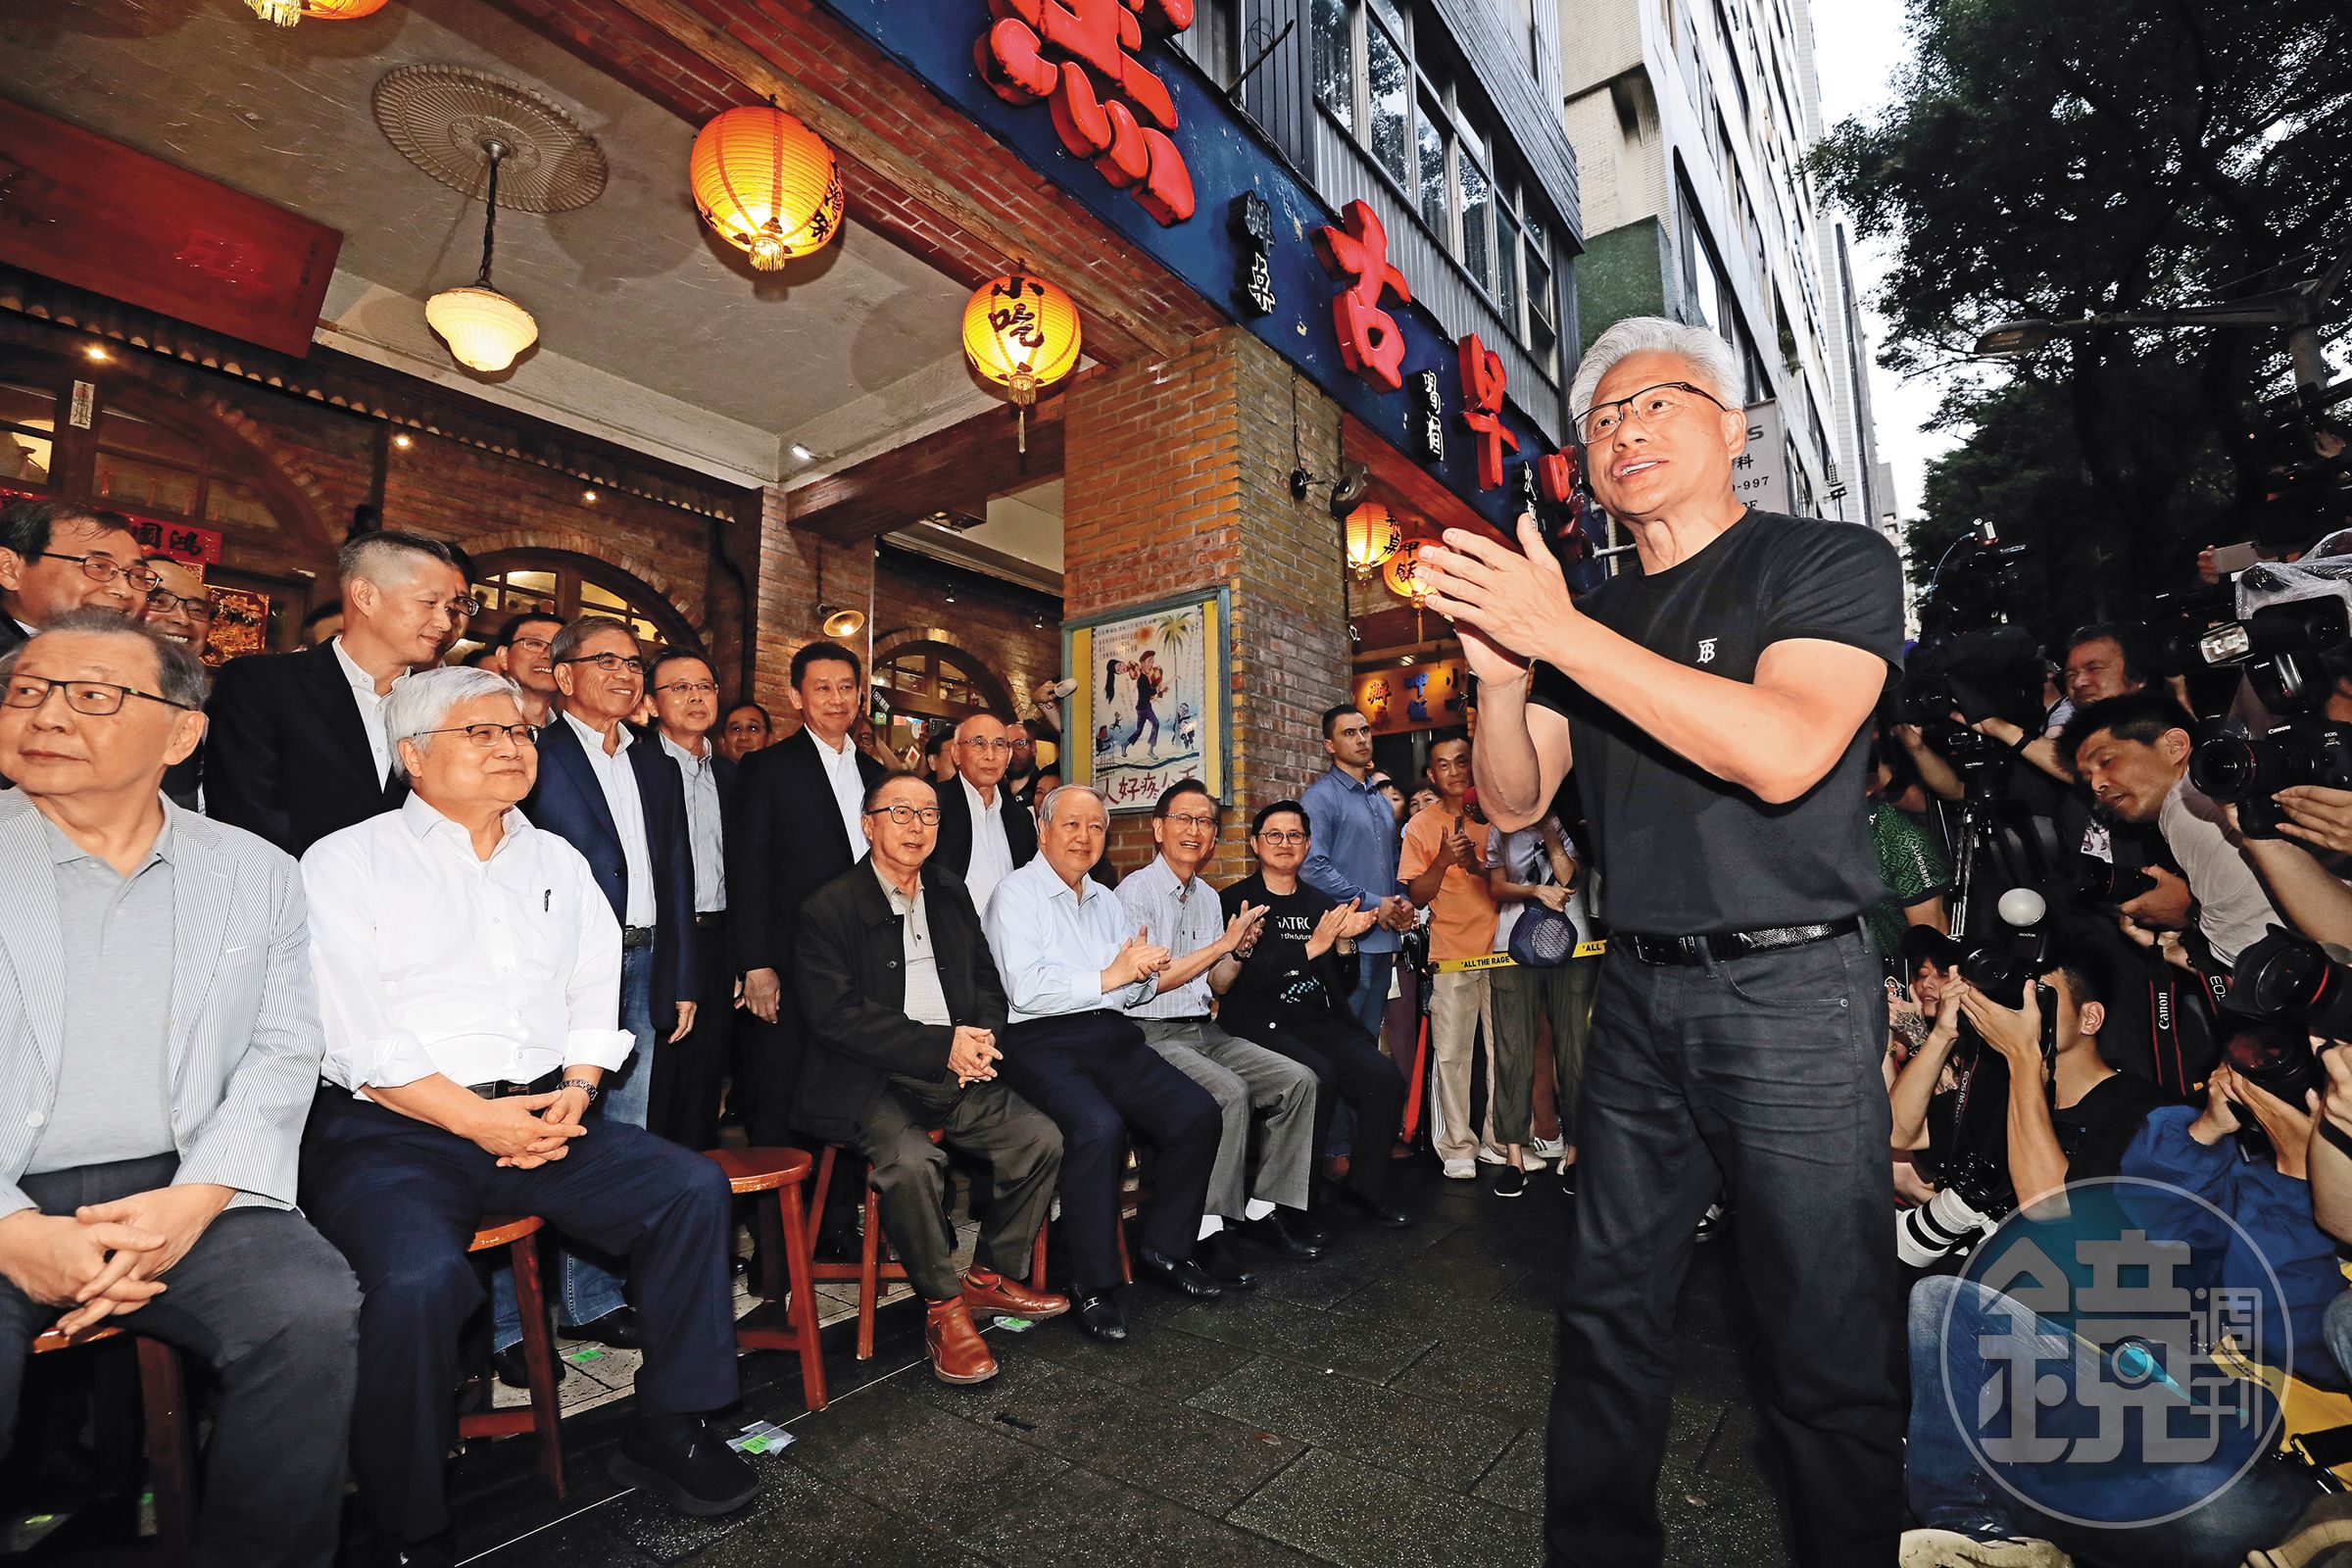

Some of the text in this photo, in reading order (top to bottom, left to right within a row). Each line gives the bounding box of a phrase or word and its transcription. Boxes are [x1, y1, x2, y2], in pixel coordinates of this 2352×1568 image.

[988, 275, 1045, 349] 小吃
[2268, 724, 2291, 735] Canon
[1477, 957, 1490, 966] THE
[1492, 956, 1510, 964] RAGE
[2158, 992, 2170, 1030] Canon
